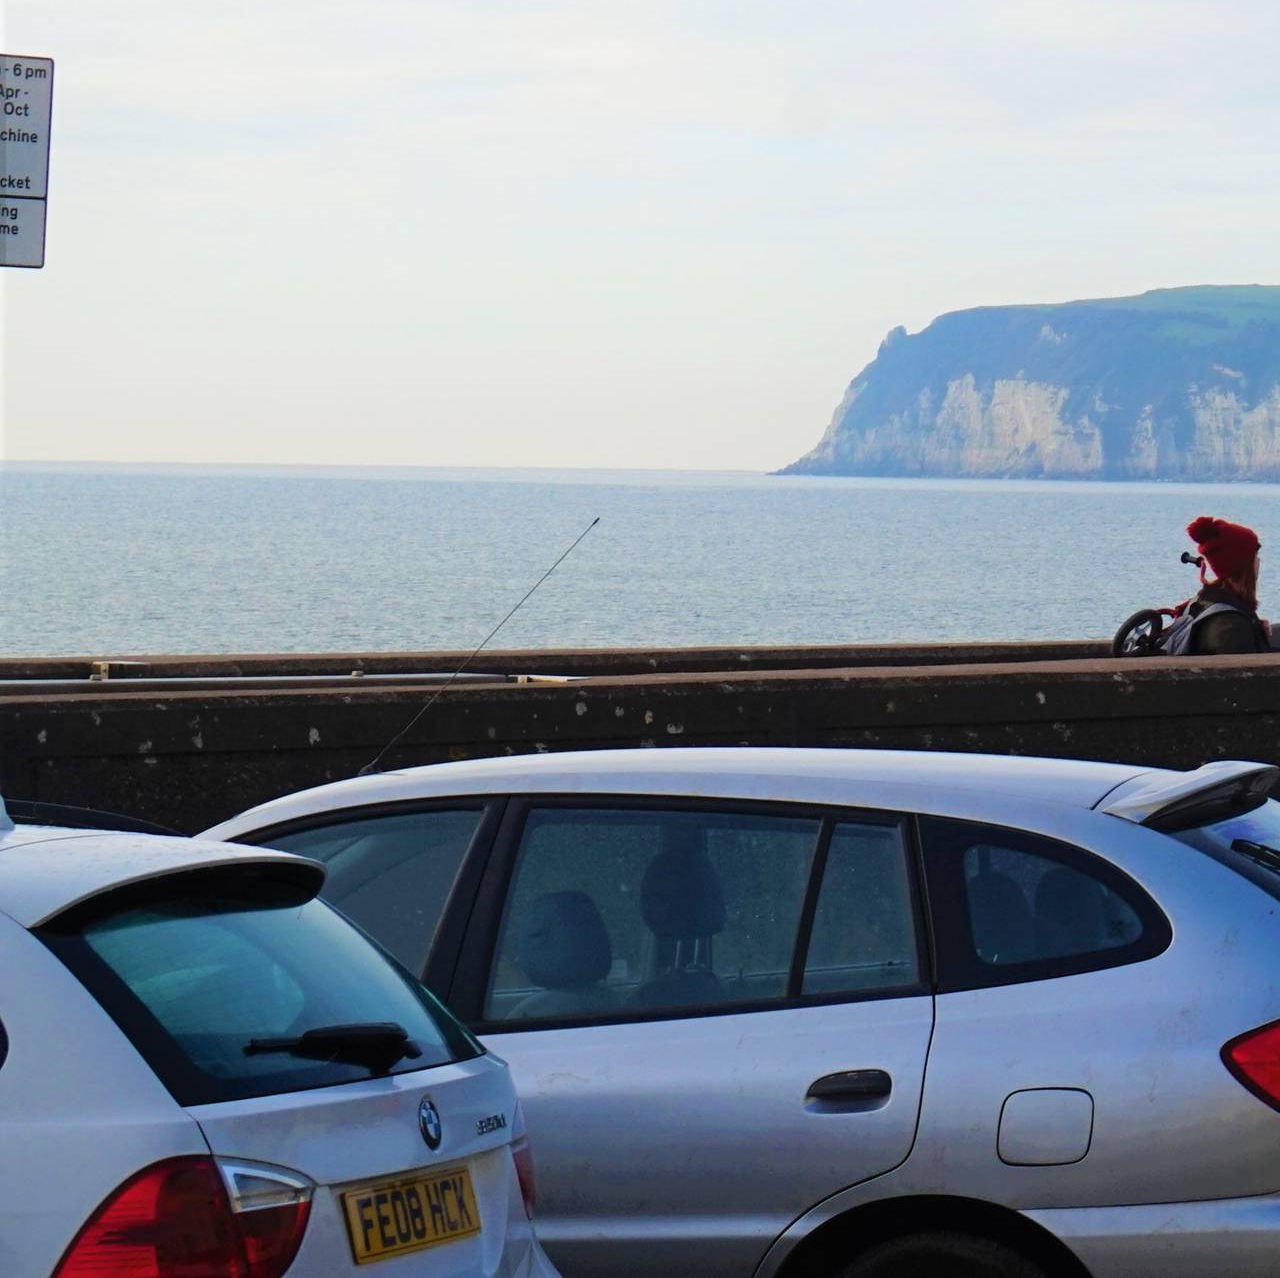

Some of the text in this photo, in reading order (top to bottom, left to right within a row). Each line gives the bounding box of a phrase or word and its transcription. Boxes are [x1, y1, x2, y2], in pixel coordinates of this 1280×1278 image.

[13, 63, 22, 77] 6
[25, 67, 47, 79] pm
[3, 101, 30, 117] Oct
[425, 1175, 473, 1236] HCK
